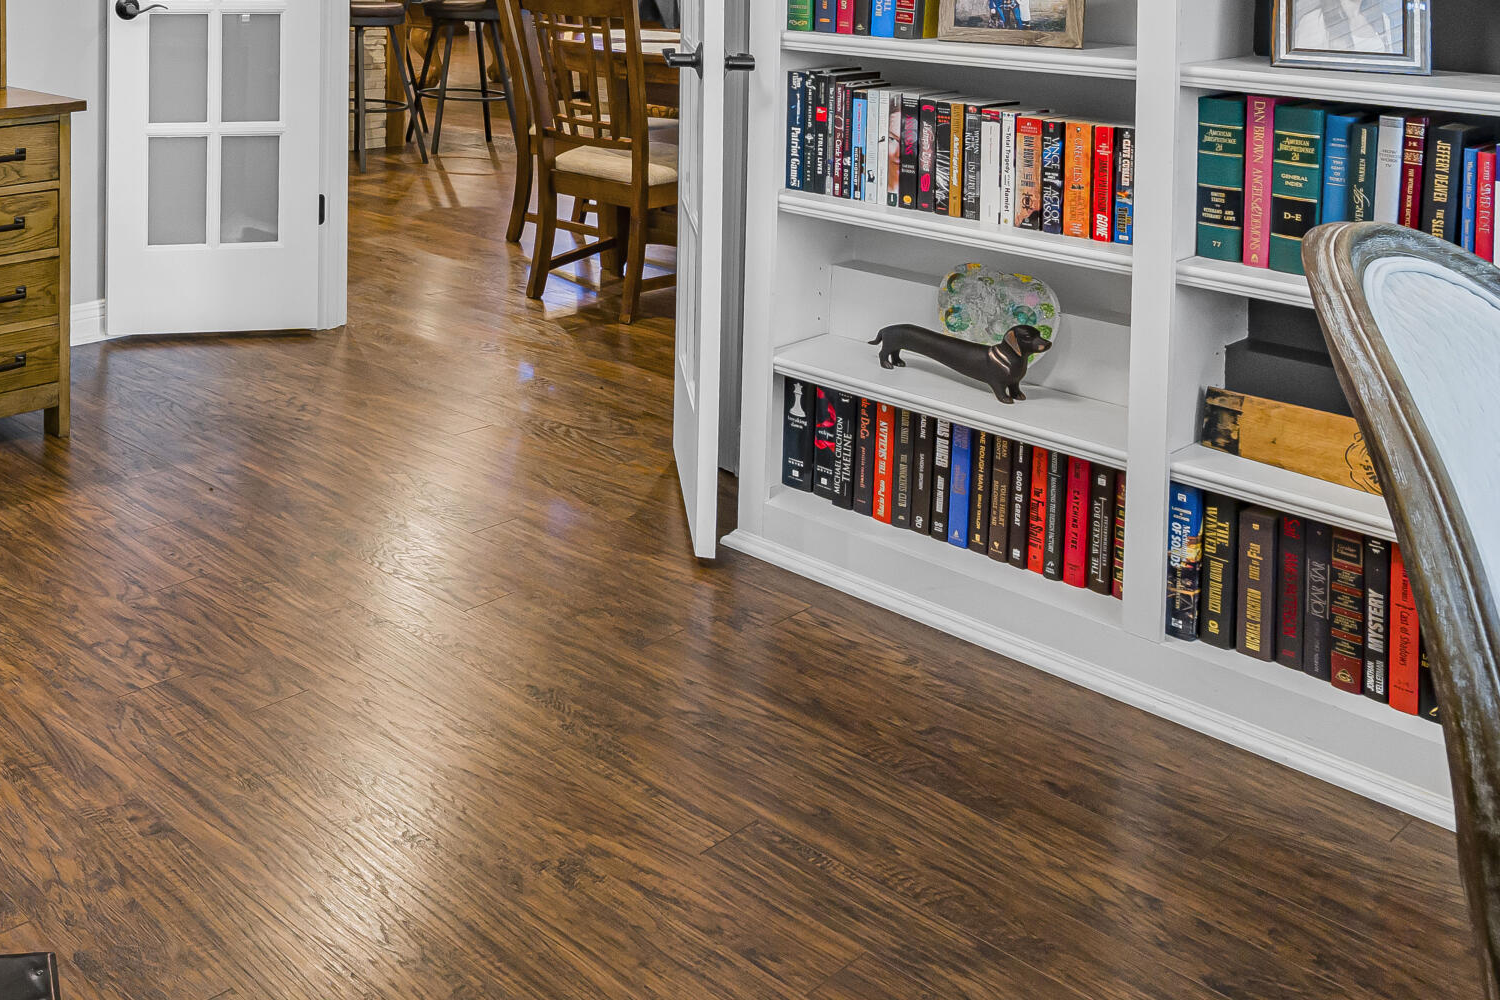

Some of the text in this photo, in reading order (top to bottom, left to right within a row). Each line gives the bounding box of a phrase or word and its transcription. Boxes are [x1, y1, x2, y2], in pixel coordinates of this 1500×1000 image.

[791, 72, 799, 90] Clancy
[965, 132, 973, 151] RUN
[1024, 135, 1034, 147] DAN
[1202, 135, 1236, 145] JURISPRUDENCE
[1207, 128, 1232, 138] AMERICAN
[1215, 143, 1223, 151] 2d
[1252, 100, 1266, 163] DAN BROWN
[1282, 137, 1310, 146] AMERICAN
[790, 126, 801, 187] Patriot Games
[1024, 148, 1035, 168] BROWN
[1043, 136, 1052, 168] FLYNN
[1052, 137, 1060, 169] VINCE
[1074, 137, 1083, 161] GREG
[1122, 139, 1131, 186] CLIVE CUSSLER
[1277, 143, 1315, 154] JURISPRUDENCE
[1291, 152, 1300, 160] 2d
[1252, 168, 1263, 202] ANGELS
[1280, 173, 1308, 182] GENERAL
[1358, 158, 1366, 183] WARREN
[1433, 140, 1452, 203] JEFFERY DEAVER
[1043, 186, 1052, 226] TREASON
[1051, 189, 1060, 224] ACT OF
[1117, 207, 1128, 233] THIEF
[1284, 211, 1302, 222] D-E
[1479, 183, 1491, 234] SILVER ROSE
[1096, 213, 1109, 238] GONE
[1250, 214, 1261, 250] DEMONS
[1431, 209, 1445, 239] THE SLEE
[834, 417, 843, 494] MICHAEL CRICHTON
[878, 421, 888, 458] SICILIAN
[935, 437, 949, 467] RANGER
[842, 433, 852, 482] TIMELINE
[977, 445, 986, 491] ROUGH MAN
[1015, 470, 1023, 492] GOOD
[1050, 477, 1058, 502] MANAGING
[1015, 493, 1023, 502] TO
[1030, 488, 1044, 542] The Fourth Stall
[1070, 490, 1080, 550] CATCHING FIRE
[1204, 506, 1218, 553] WINNER
[1047, 532, 1055, 553] FACTORY
[1091, 500, 1102, 575] THE WICKED BOY
[1170, 522, 1181, 567] OF SOLIDS
[1181, 524, 1191, 562] Mechanics
[1216, 521, 1230, 547] THE
[1208, 560, 1224, 614] DAVID BALDACCI
[1282, 517, 1300, 638] Sail JAMES PATTERSON
[1309, 561, 1326, 618] POLAR STAR
[1245, 588, 1261, 652] MICHAEL CRICHTON
[1367, 588, 1384, 653] MYSTERY
[1400, 611, 1410, 625] Cast
[1400, 627, 1410, 635] of
[1399, 635, 1411, 666] Shadows
[1366, 660, 1375, 692] JONATHAN
[1375, 660, 1385, 696] KELLERMAN
